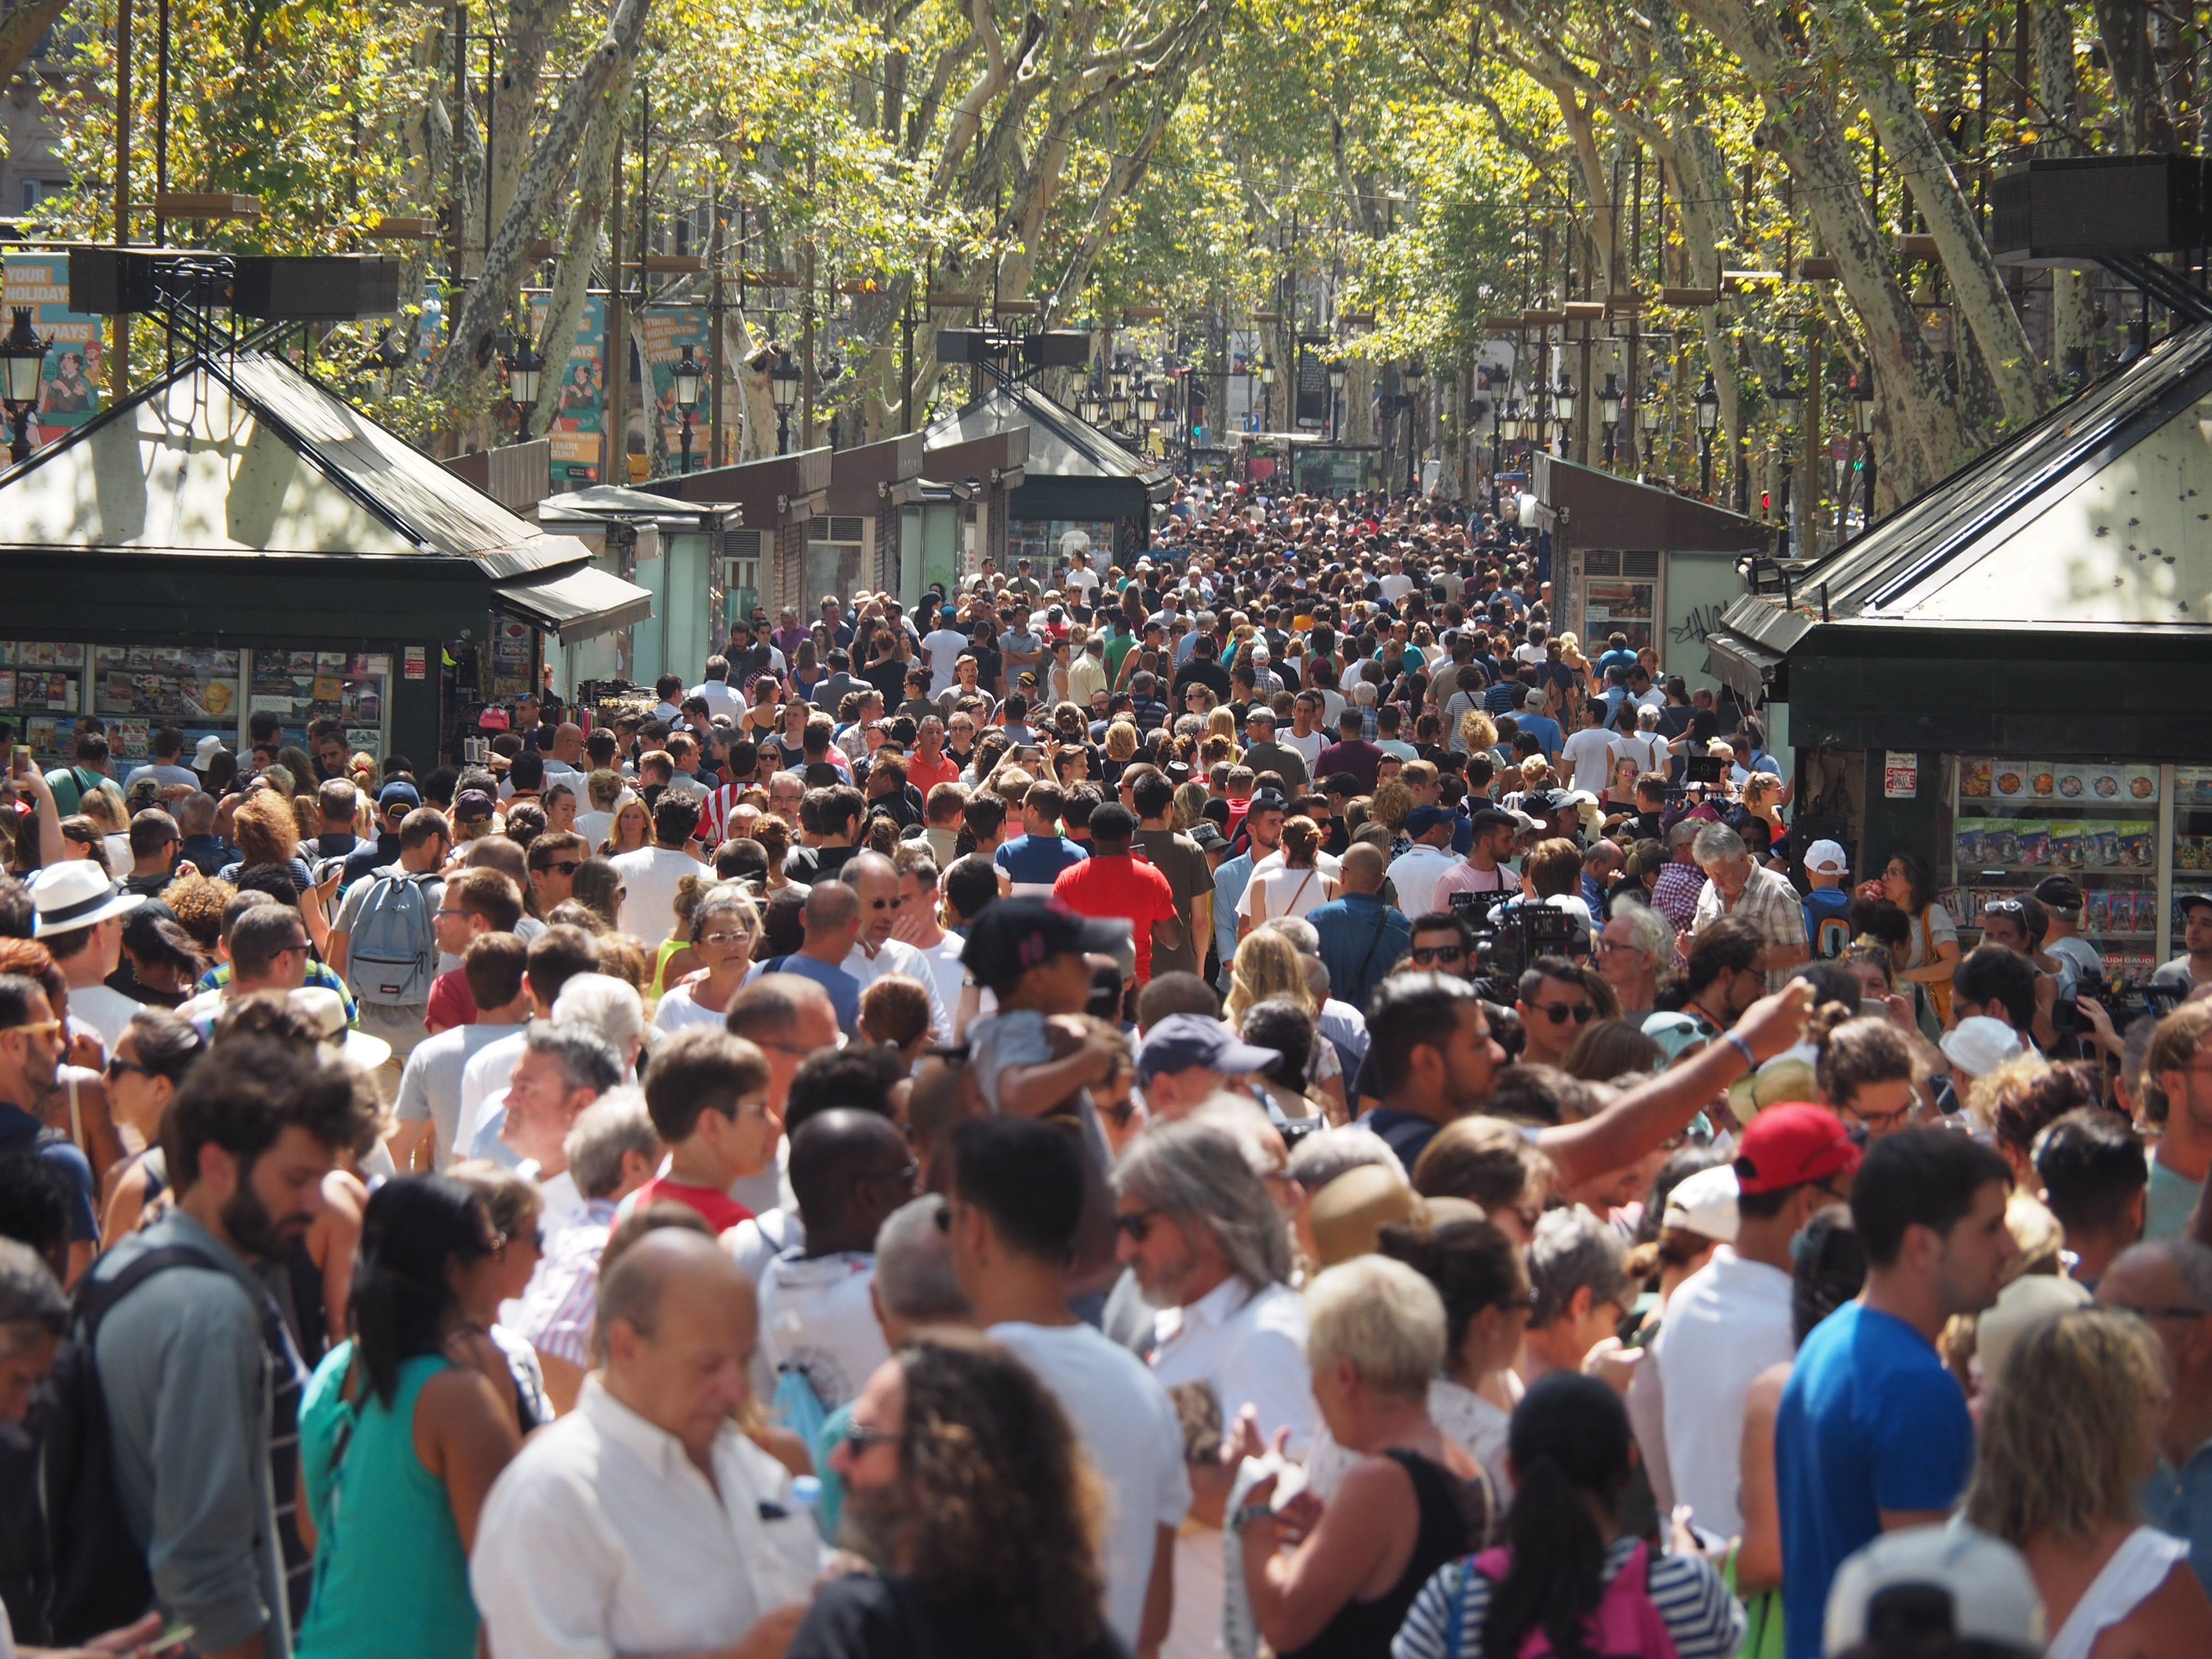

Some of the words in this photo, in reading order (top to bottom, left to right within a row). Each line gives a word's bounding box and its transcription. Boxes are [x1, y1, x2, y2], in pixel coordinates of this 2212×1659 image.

[7, 268, 45, 281] YOUR
[5, 286, 69, 301] HOLIDAY
[2, 325, 89, 340] ERYDAYS
[649, 338, 669, 349] OUR
[556, 442, 579, 451] SHARE
